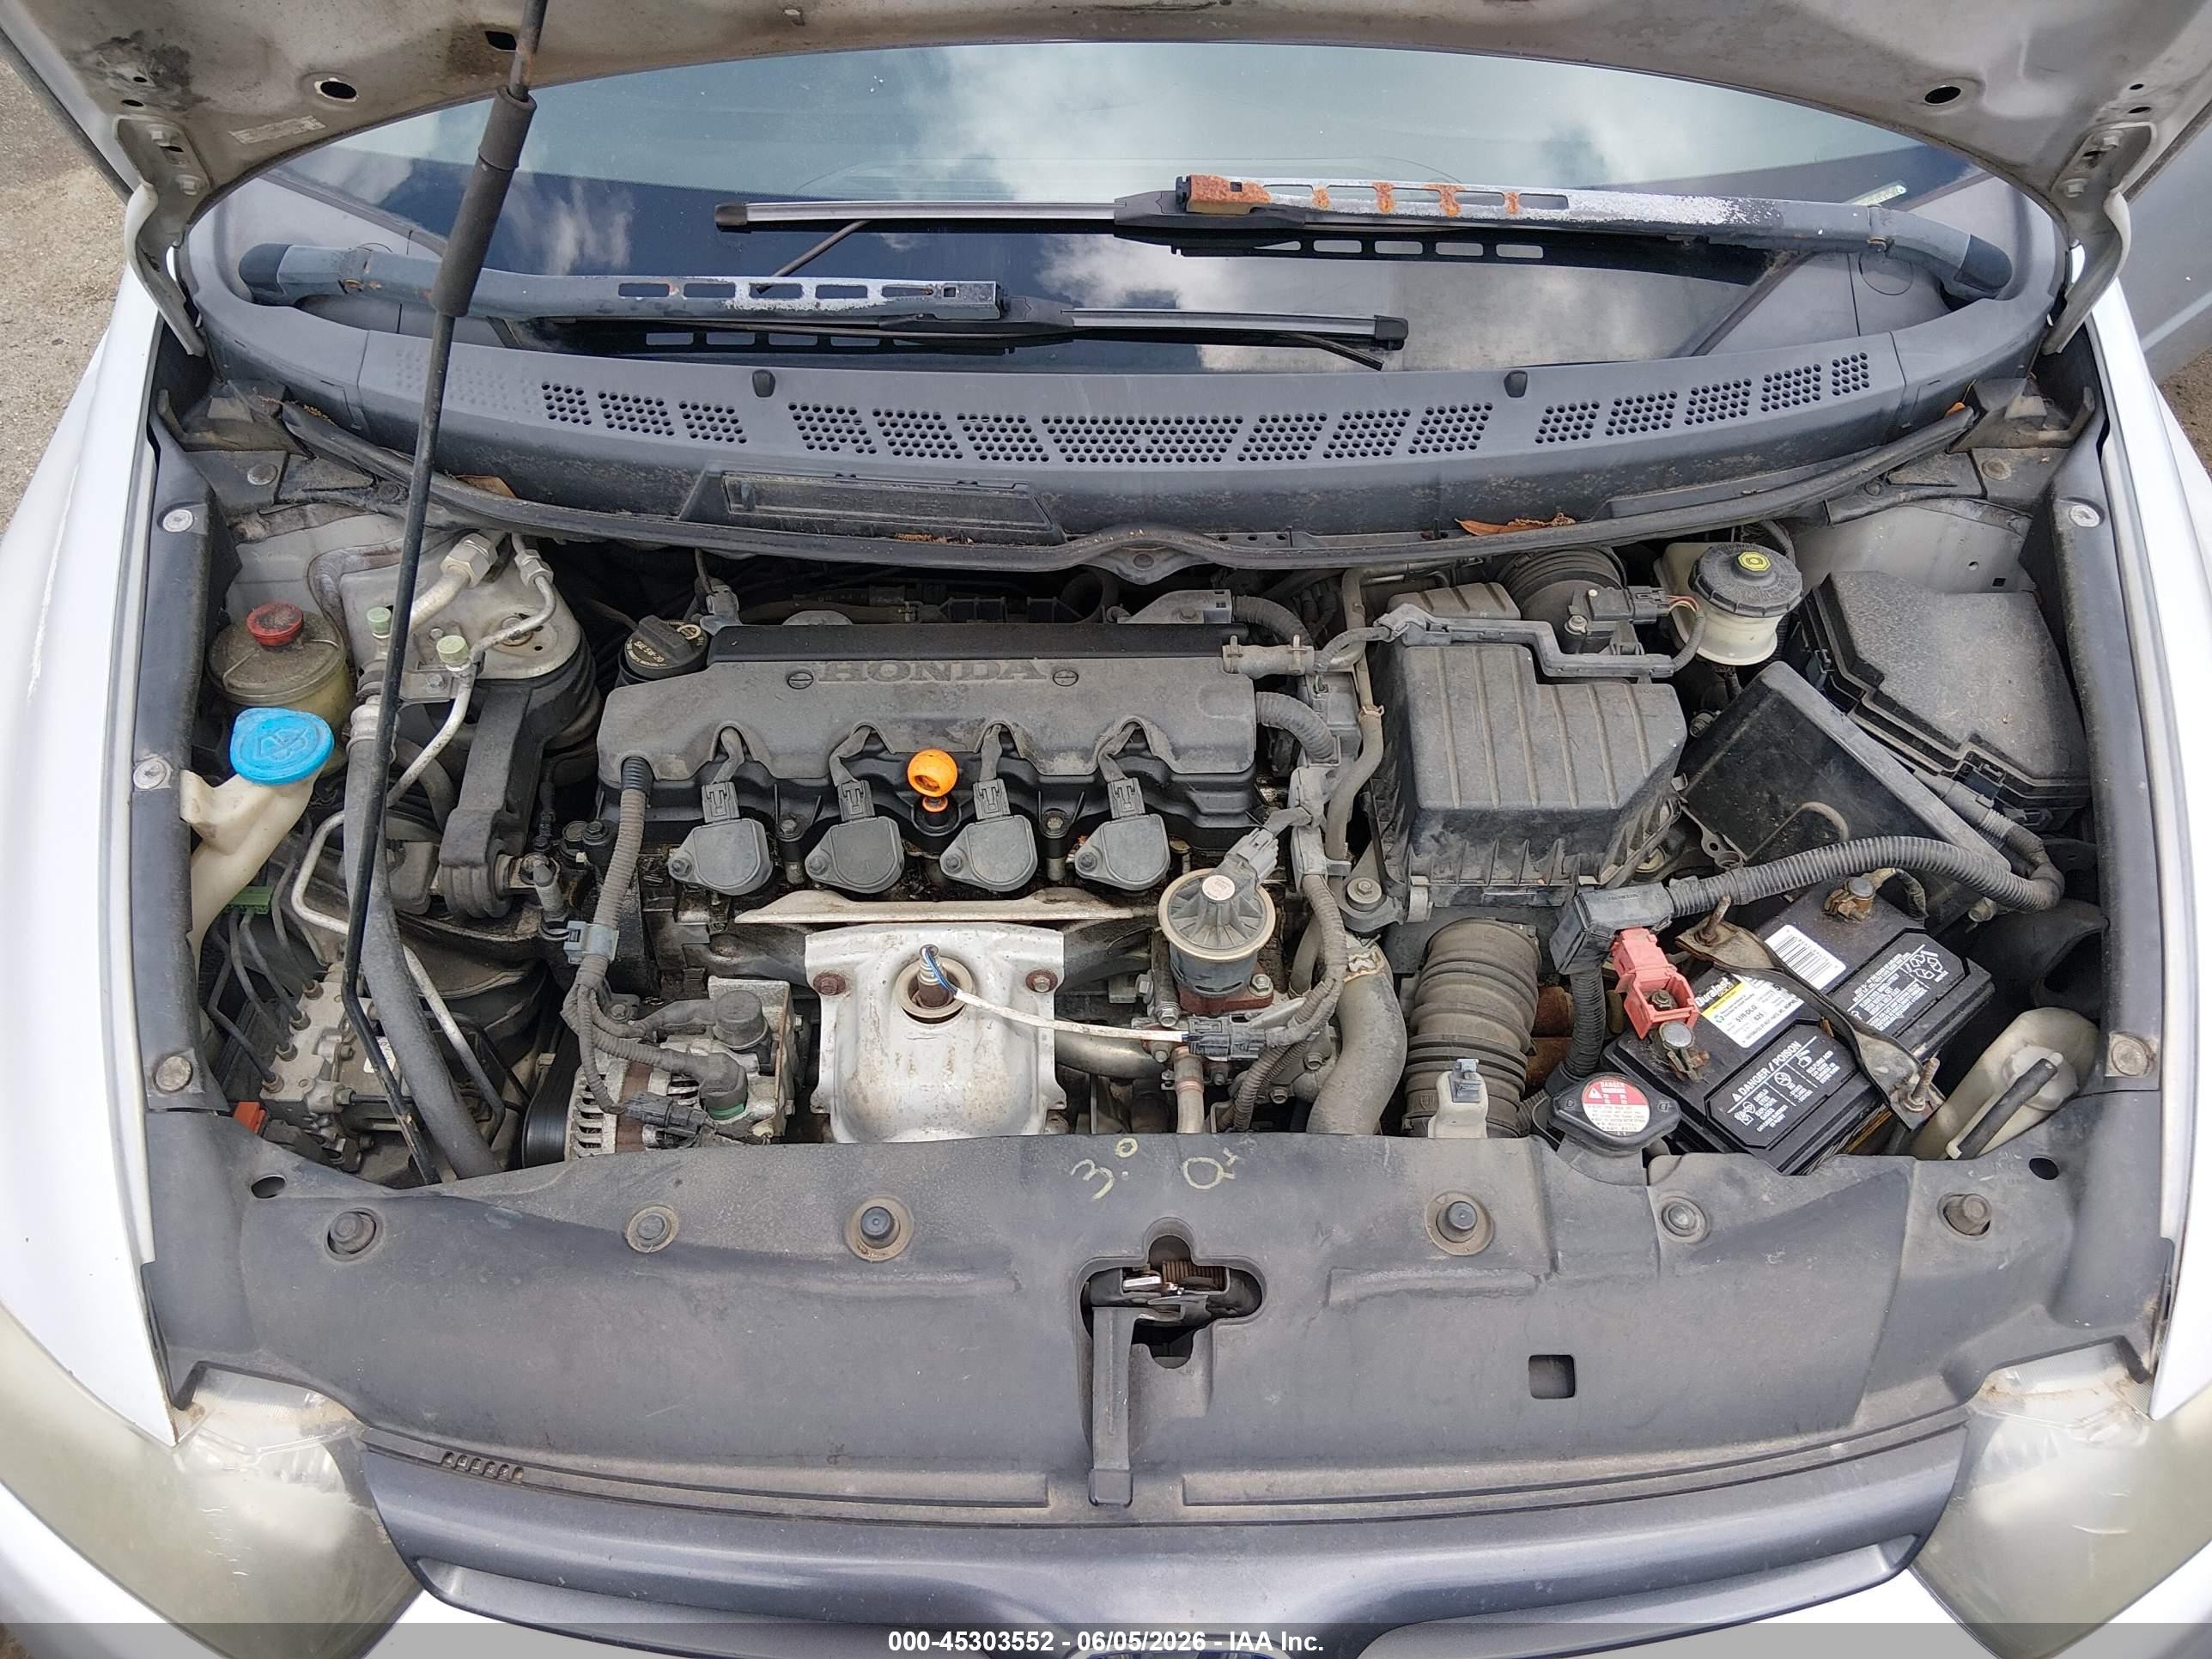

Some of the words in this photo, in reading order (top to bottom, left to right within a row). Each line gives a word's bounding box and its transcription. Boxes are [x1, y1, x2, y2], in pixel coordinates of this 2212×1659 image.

[817, 660, 1047, 683] HONDA
[1694, 976, 1731, 1007] Duralast
[1737, 1067, 1770, 1096] DANGER
[1772, 1040, 1802, 1066] POISON
